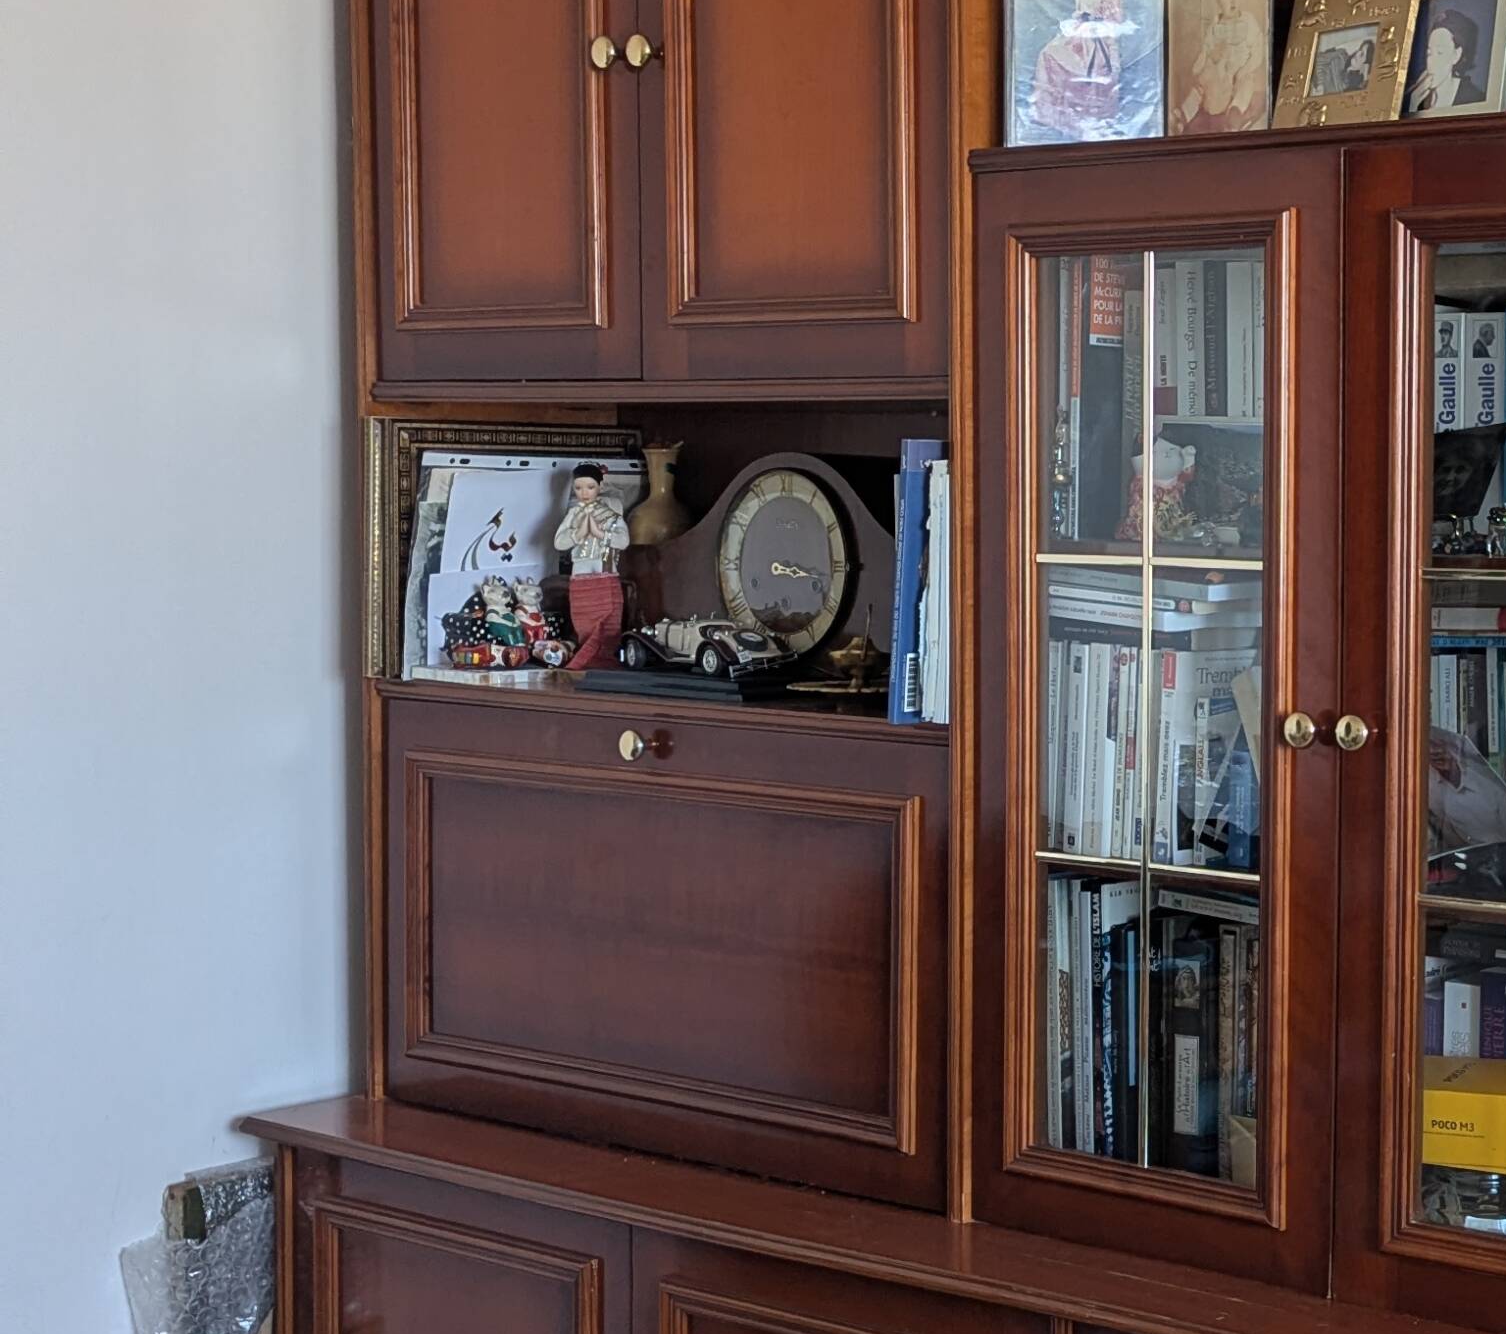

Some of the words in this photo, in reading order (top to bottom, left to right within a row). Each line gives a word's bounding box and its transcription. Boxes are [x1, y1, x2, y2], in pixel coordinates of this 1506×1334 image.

[1094, 272, 1104, 283] DE
[1093, 300, 1114, 312] POUR
[1093, 314, 1103, 324] DE
[1104, 315, 1113, 325] LA
[1185, 307, 1198, 351] Bourges
[1188, 361, 1198, 377] De
[1188, 380, 1200, 417] mémoi
[1438, 362, 1457, 425] Gaulle
[1477, 362, 1495, 425] Gaulle
[1159, 764, 1170, 801] Tremblez
[1092, 892, 1101, 935] L'ISLAM
[1093, 936, 1101, 948] DE
[1093, 949, 1102, 987] HISTOIRE
[1431, 1119, 1458, 1131] POCO
[1459, 1121, 1475, 1132] M3
